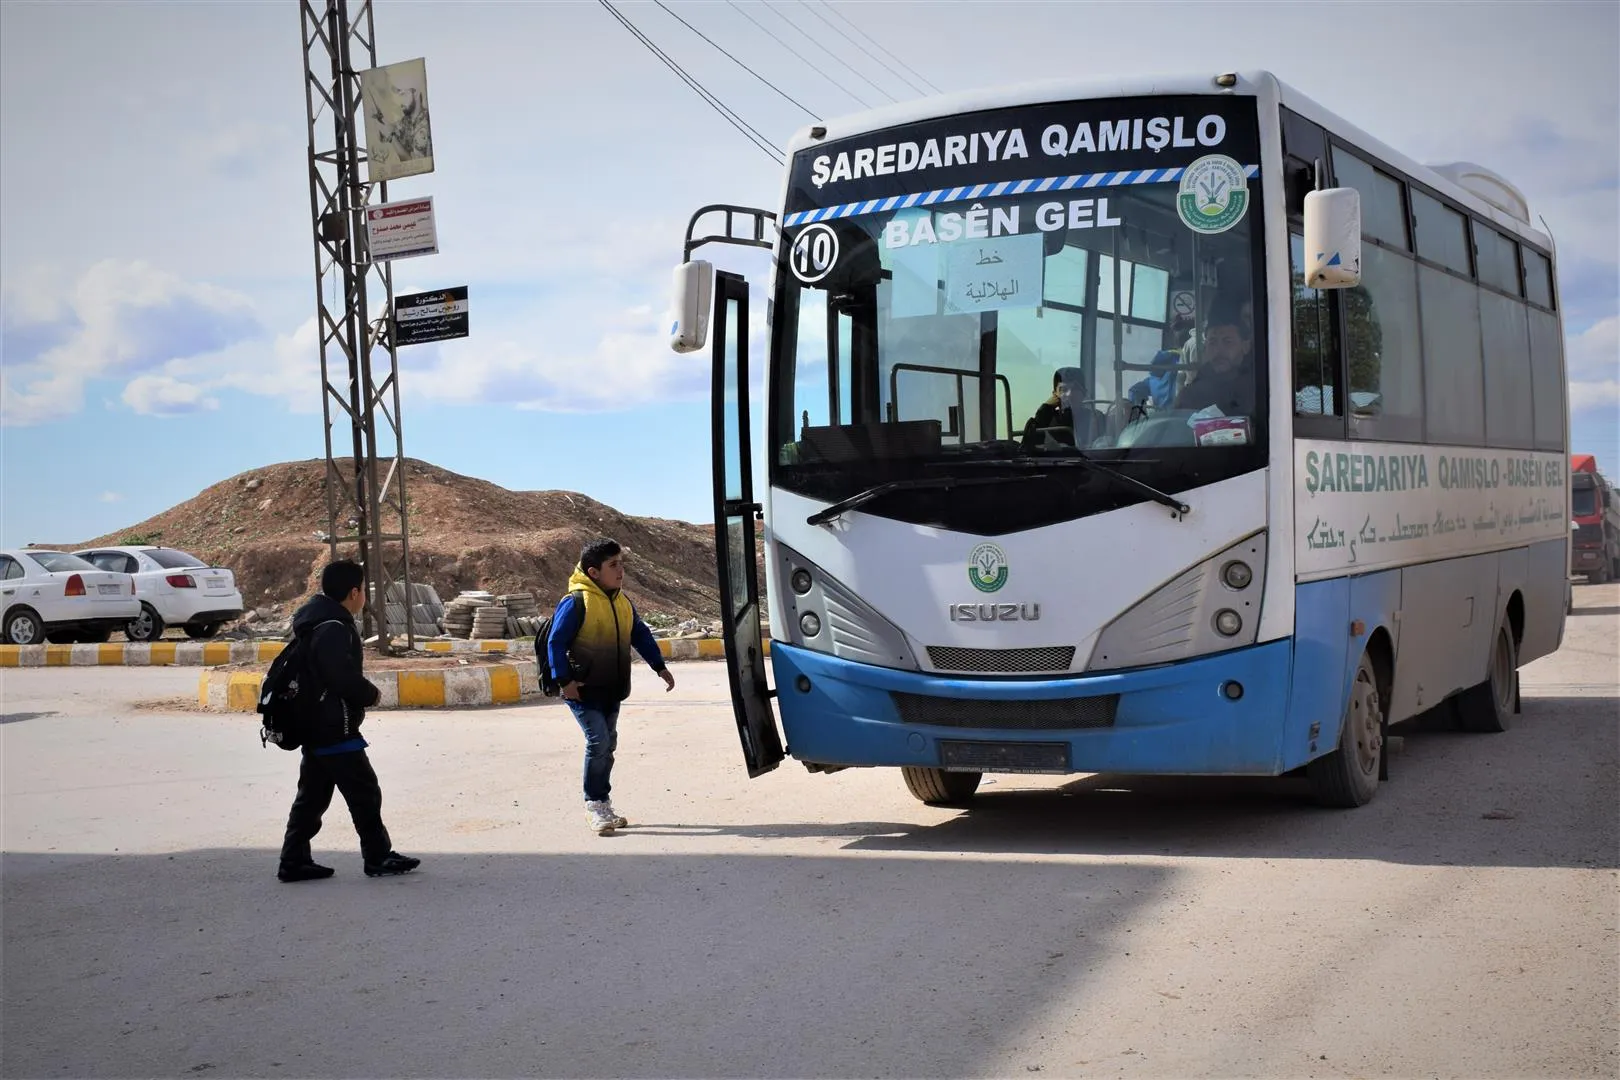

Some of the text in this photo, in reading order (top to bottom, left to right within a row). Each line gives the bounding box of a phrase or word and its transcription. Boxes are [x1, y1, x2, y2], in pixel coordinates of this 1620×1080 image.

[811, 114, 1226, 189] ŞAREDARIYA QAMIŞLO
[885, 198, 1121, 249] BASÊN GEL
[796, 232, 832, 273] 10
[975, 248, 1003, 265] خط
[966, 279, 1019, 303] الهلالية
[1305, 450, 1428, 498] ŞAREDARIYA
[1438, 455, 1500, 492] QAMIŞLO
[1545, 460, 1563, 487] GEL
[949, 602, 1041, 622] ISUZU
